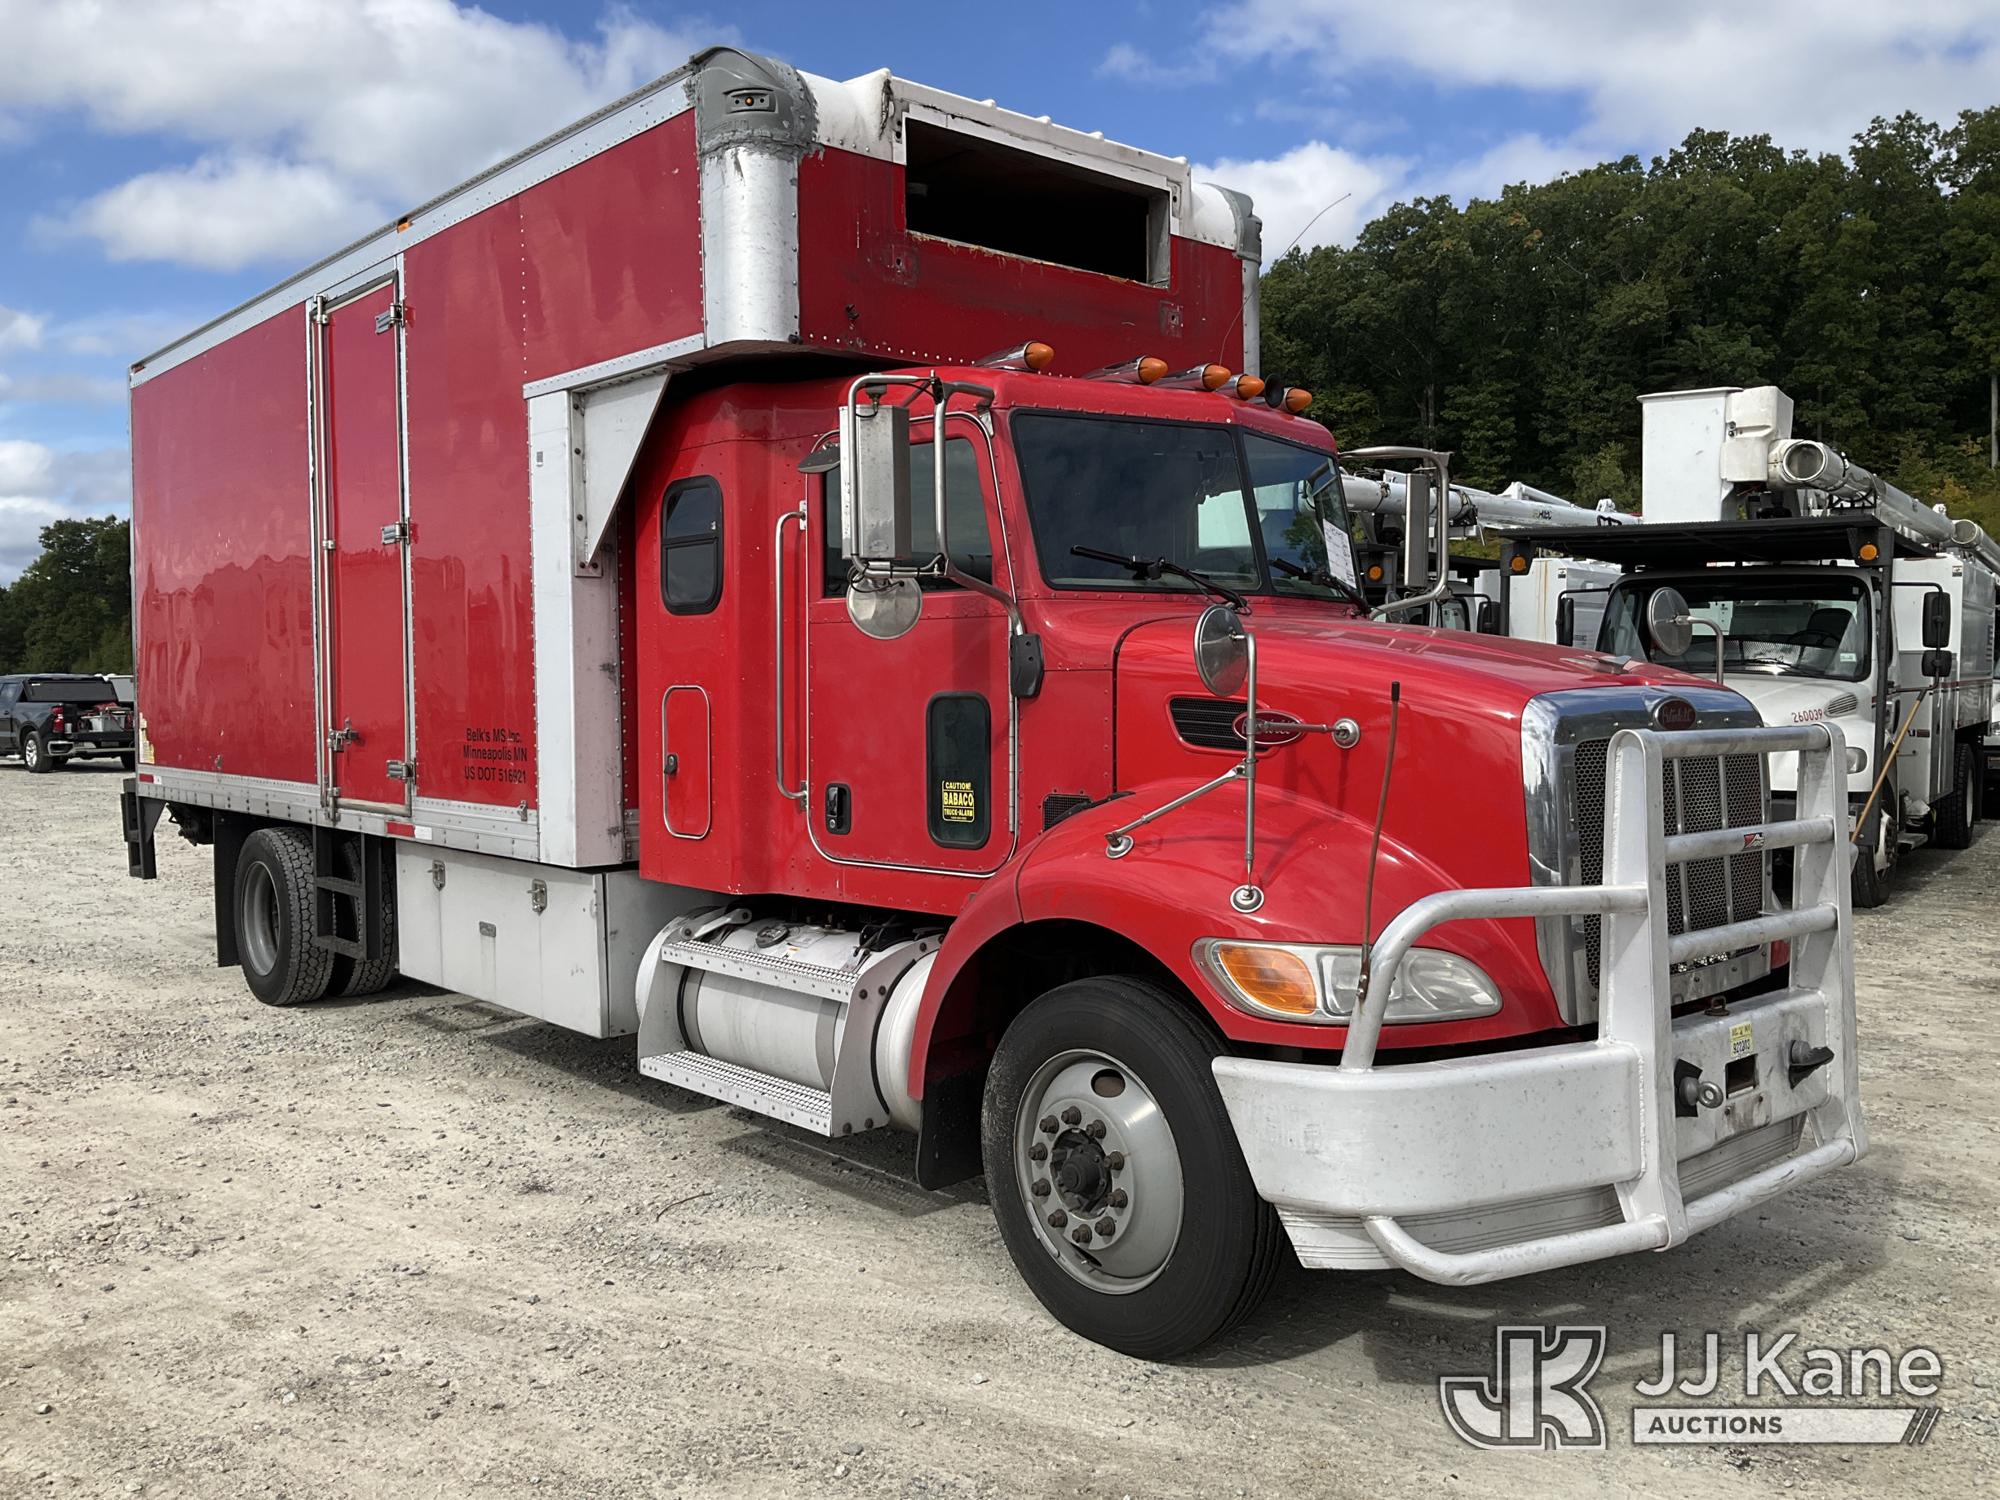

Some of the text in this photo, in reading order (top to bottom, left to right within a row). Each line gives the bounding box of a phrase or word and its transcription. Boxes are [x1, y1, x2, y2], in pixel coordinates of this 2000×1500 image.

[1791, 708, 1823, 723] 260039
[466, 727, 491, 743] Belk's
[493, 728, 507, 743] MS
[463, 744, 528, 764] Minneapolis MN
[464, 766, 476, 780] US
[477, 766, 497, 782] DOT
[943, 791, 974, 807] BABACO
